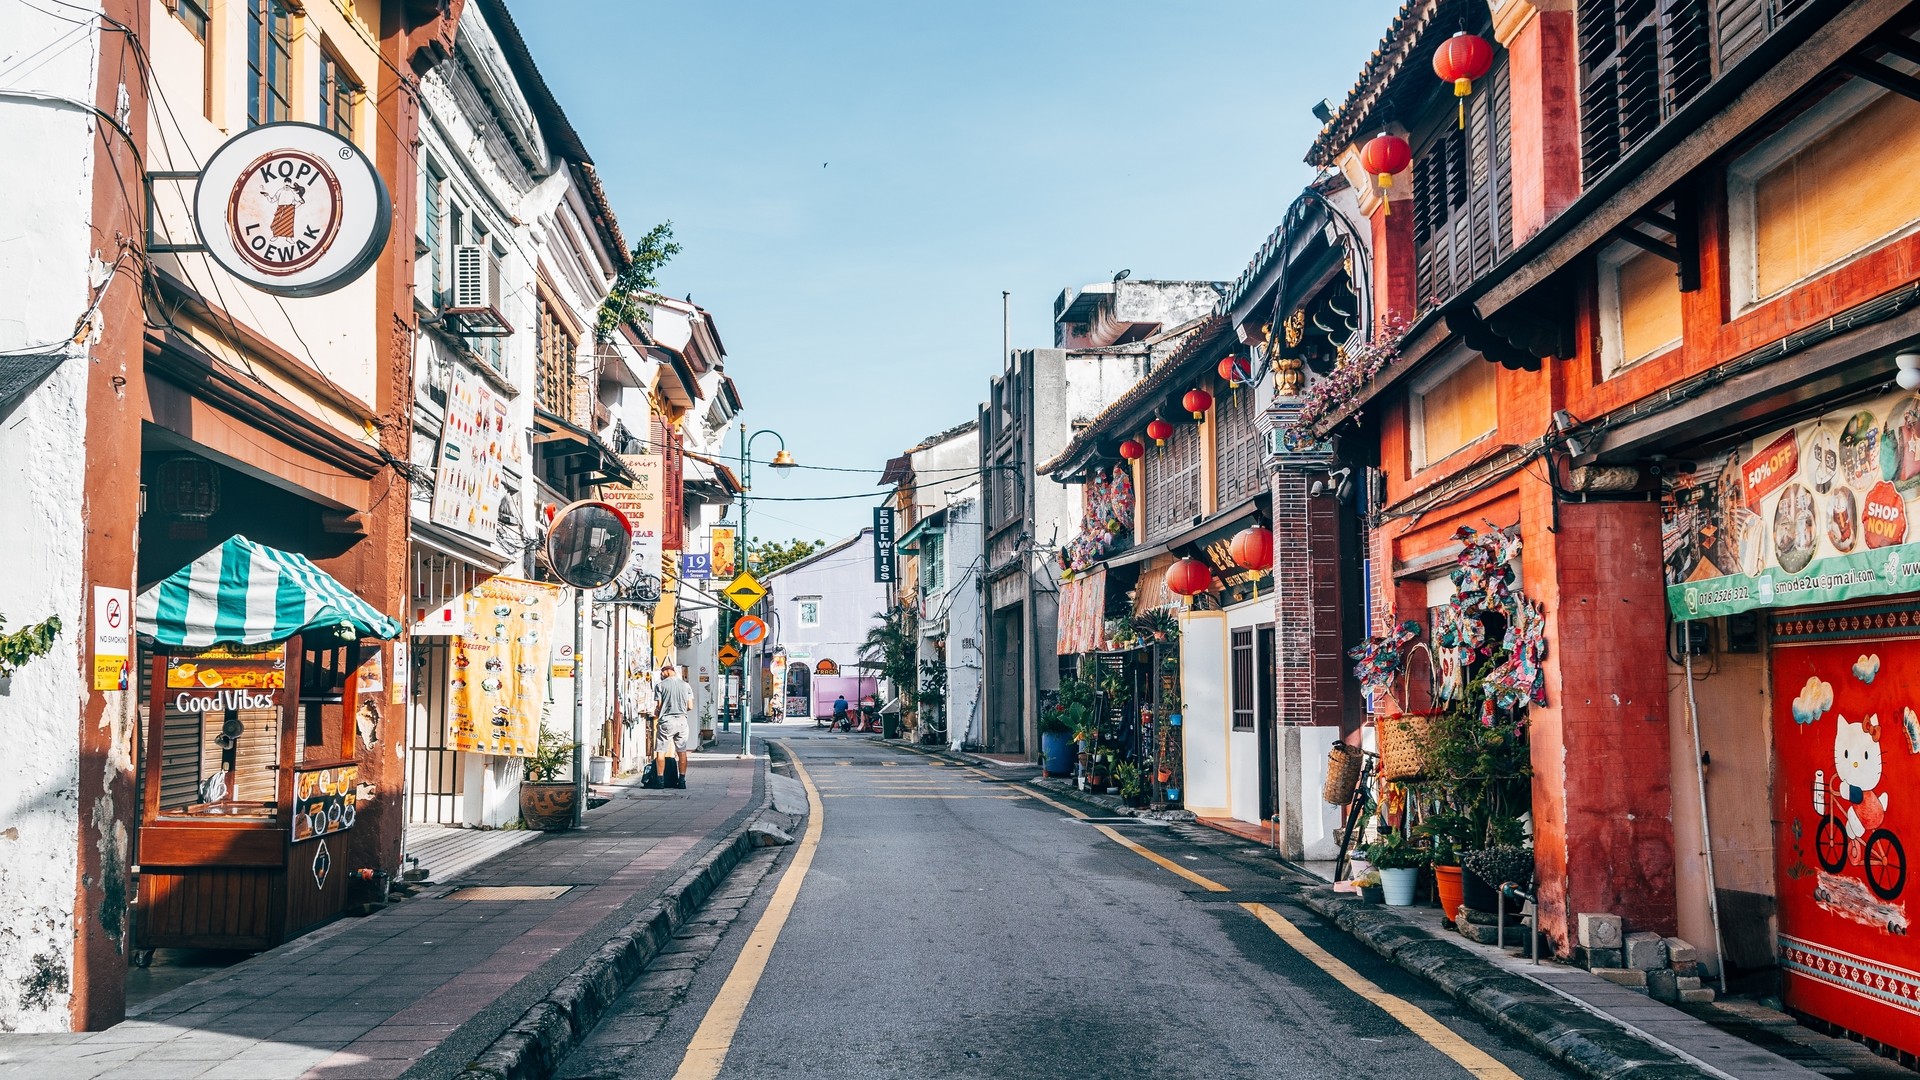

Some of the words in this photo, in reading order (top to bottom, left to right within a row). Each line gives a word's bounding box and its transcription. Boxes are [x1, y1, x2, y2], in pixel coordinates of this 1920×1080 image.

[260, 160, 320, 187] KOPI
[245, 223, 320, 262] LOEWAK
[1867, 502, 1899, 521] SHOP
[1867, 518, 1897, 538] NOW
[877, 509, 891, 580] EDELWEISS
[687, 555, 706, 569] 19
[1775, 569, 1876, 594] smode2u@gmail.com
[1699, 592, 1713, 605] 018
[1713, 589, 1732, 602] 2526
[1733, 586, 1749, 600] 322
[108, 636, 127, 644] SMOKING
[231, 642, 283, 652] CHEESE
[462, 643, 491, 652] DESSERT
[176, 690, 223, 713] Good
[225, 688, 275, 711] Vibes
